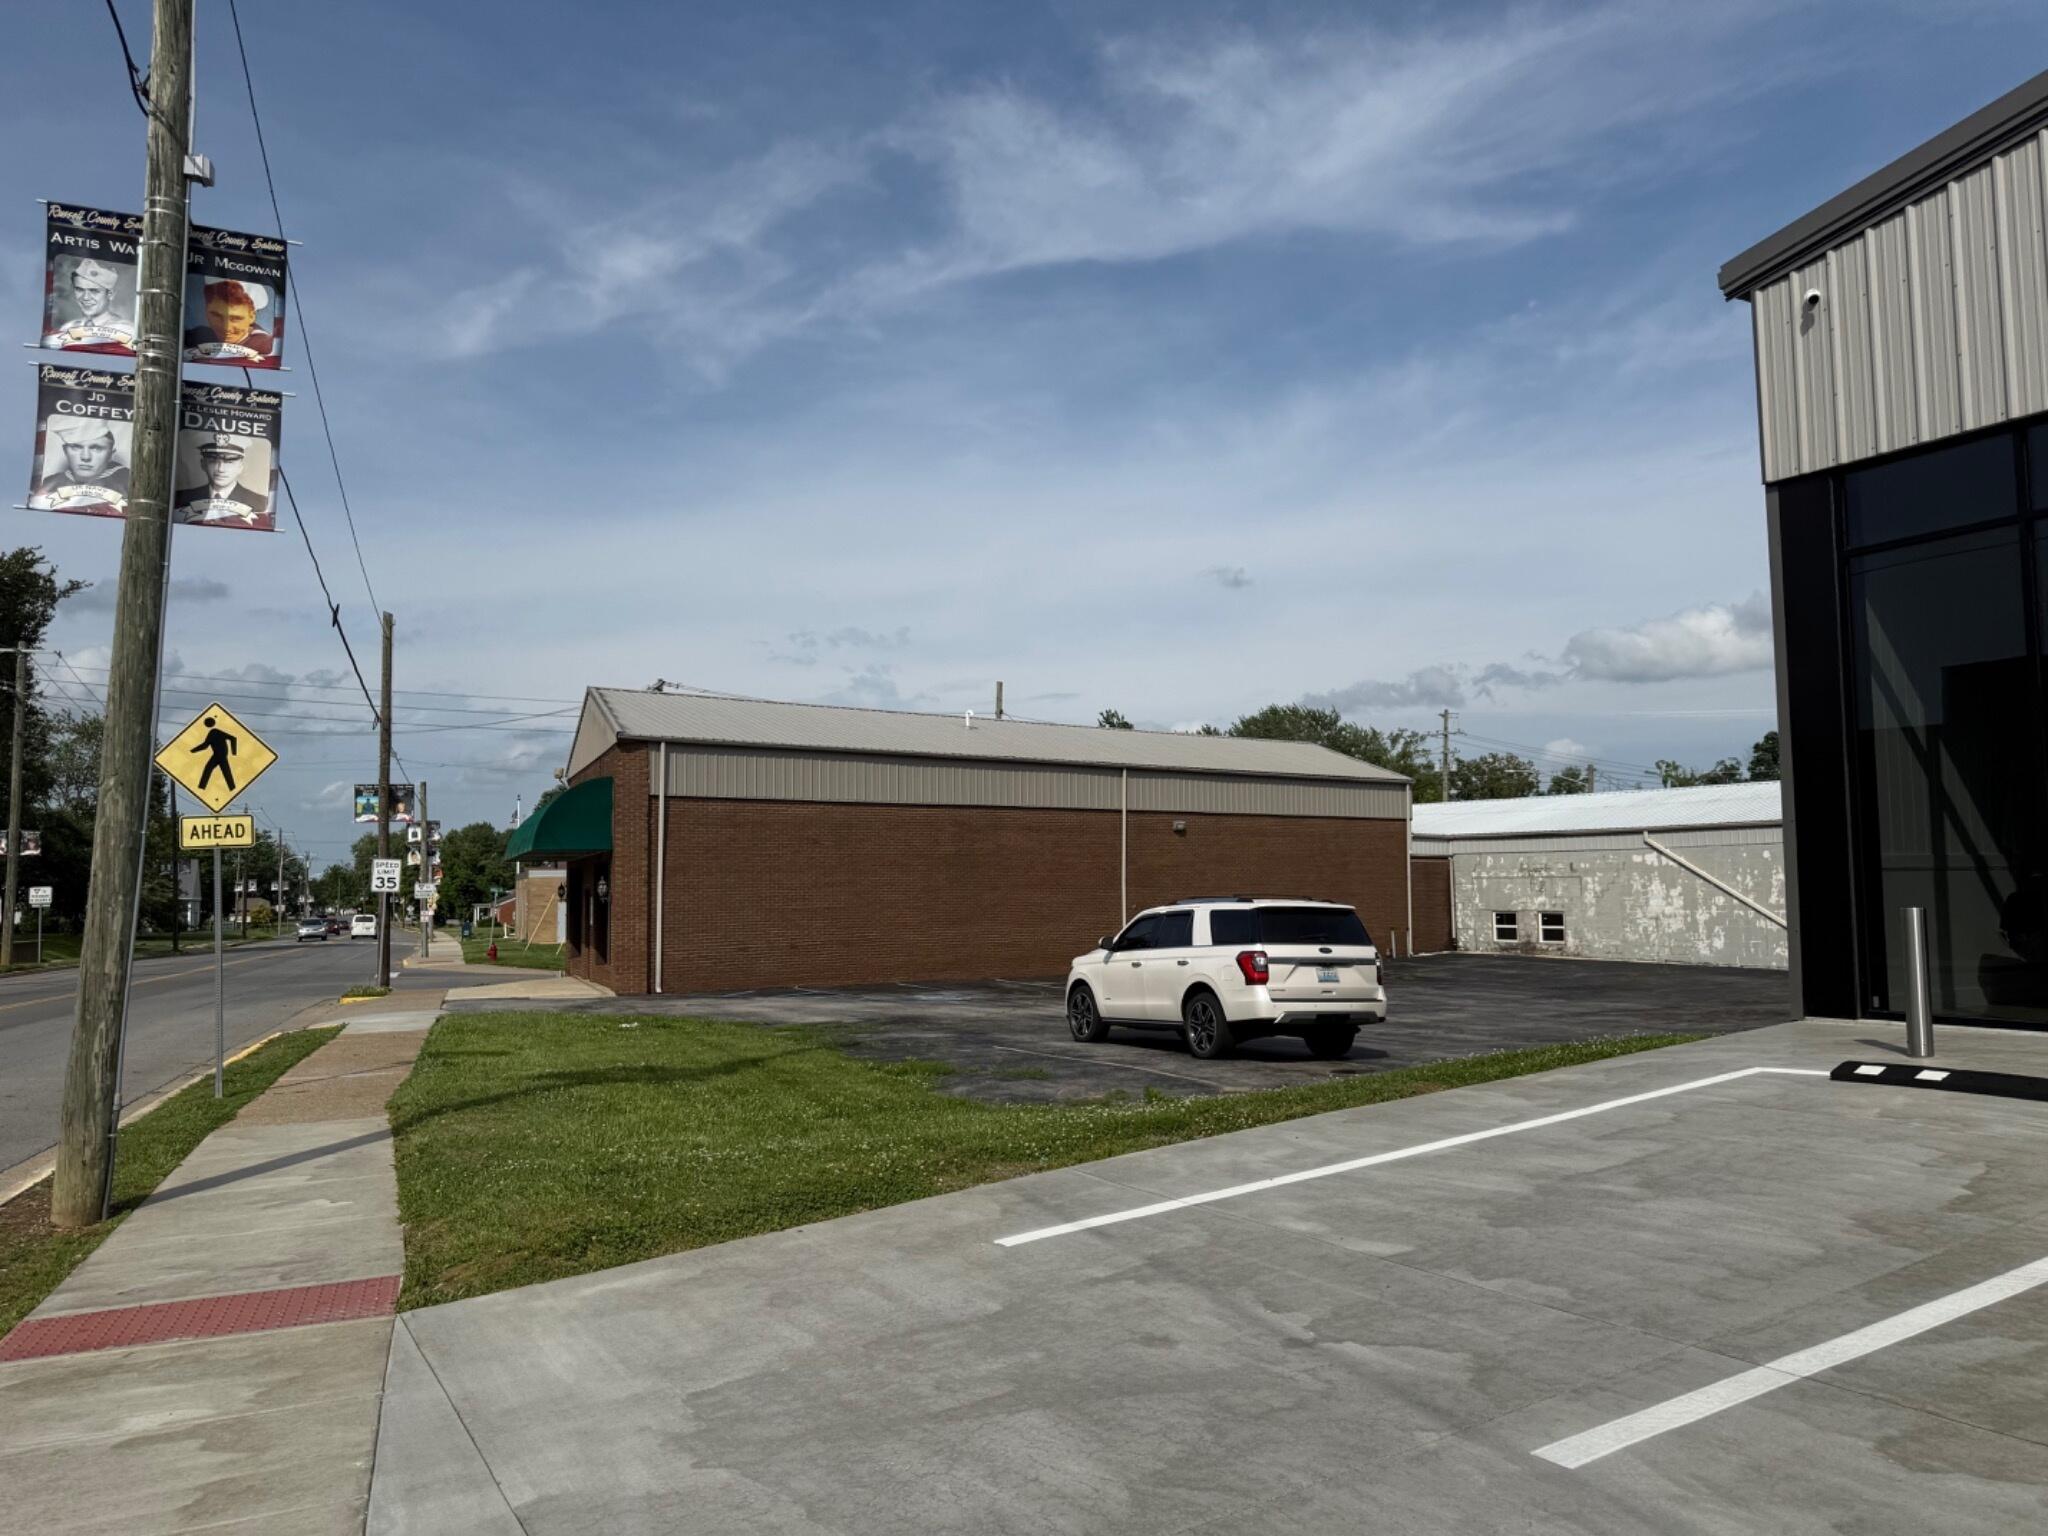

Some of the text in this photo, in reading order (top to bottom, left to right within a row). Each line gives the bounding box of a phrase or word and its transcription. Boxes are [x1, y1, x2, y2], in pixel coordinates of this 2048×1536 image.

[87, 210, 120, 231] County
[50, 232, 100, 249] ARTIS
[217, 231, 249, 251] County
[80, 370, 114, 389] County
[211, 386, 243, 405] County
[56, 400, 135, 420] COFFEY
[230, 409, 272, 421] HOWARD
[184, 411, 267, 436] DAUSE
[190, 822, 246, 840] AHEAD
[375, 876, 397, 889] 35
